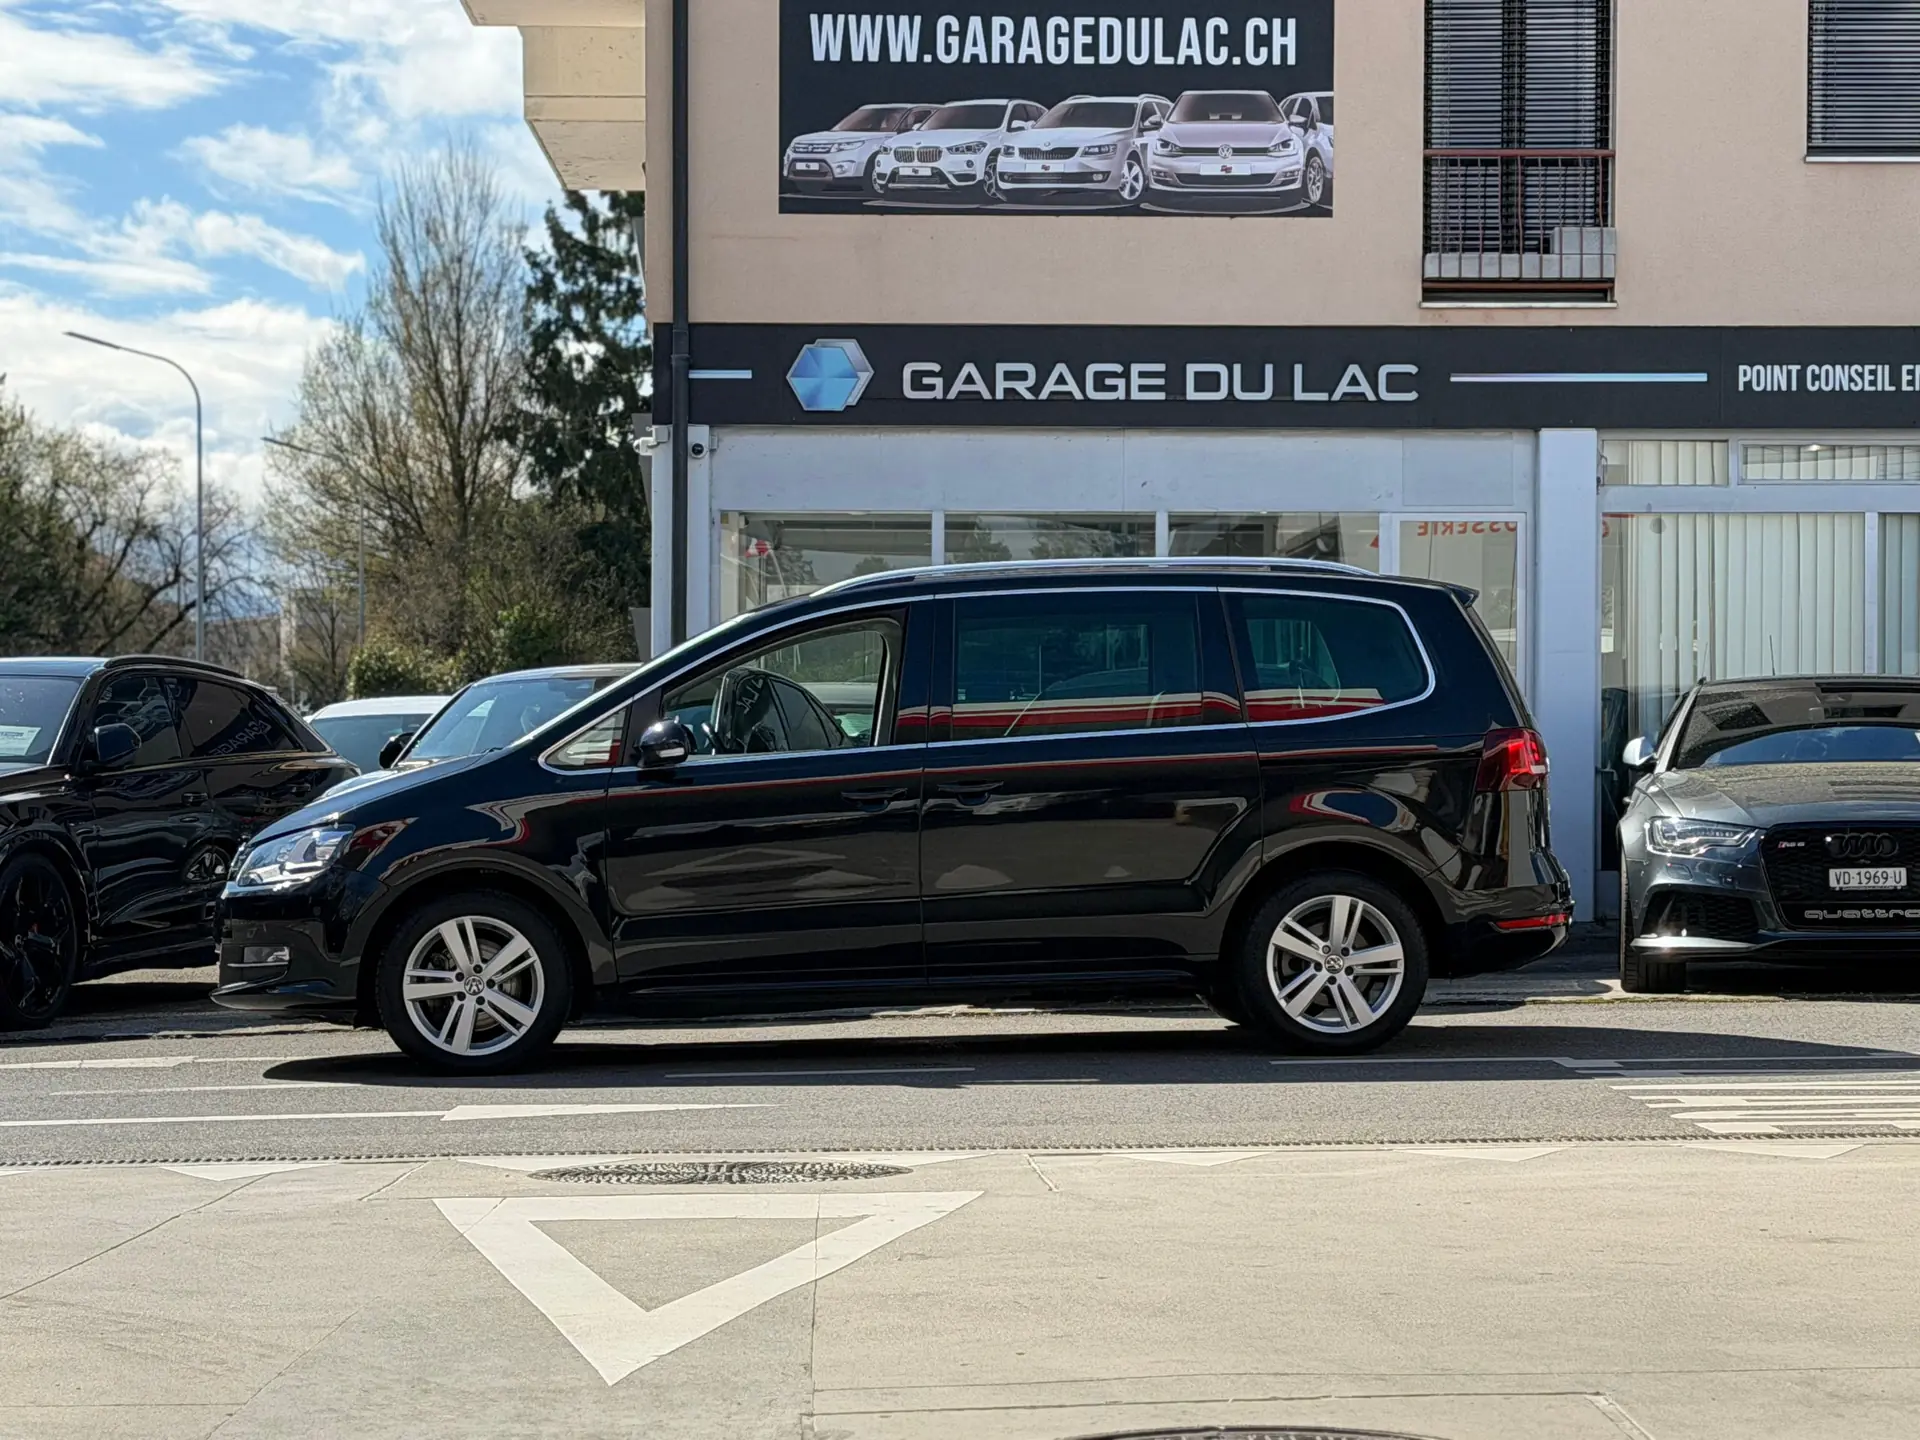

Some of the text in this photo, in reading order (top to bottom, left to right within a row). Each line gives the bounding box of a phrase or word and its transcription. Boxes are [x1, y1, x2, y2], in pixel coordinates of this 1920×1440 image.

[809, 13, 1297, 66] WWW.GARAGEDULAC.CH
[902, 362, 1418, 401] GARAGE DU LAC
[1738, 364, 1801, 391] POINT
[1806, 364, 1896, 391] CONSEIL
[1804, 909, 1920, 920] quattro
